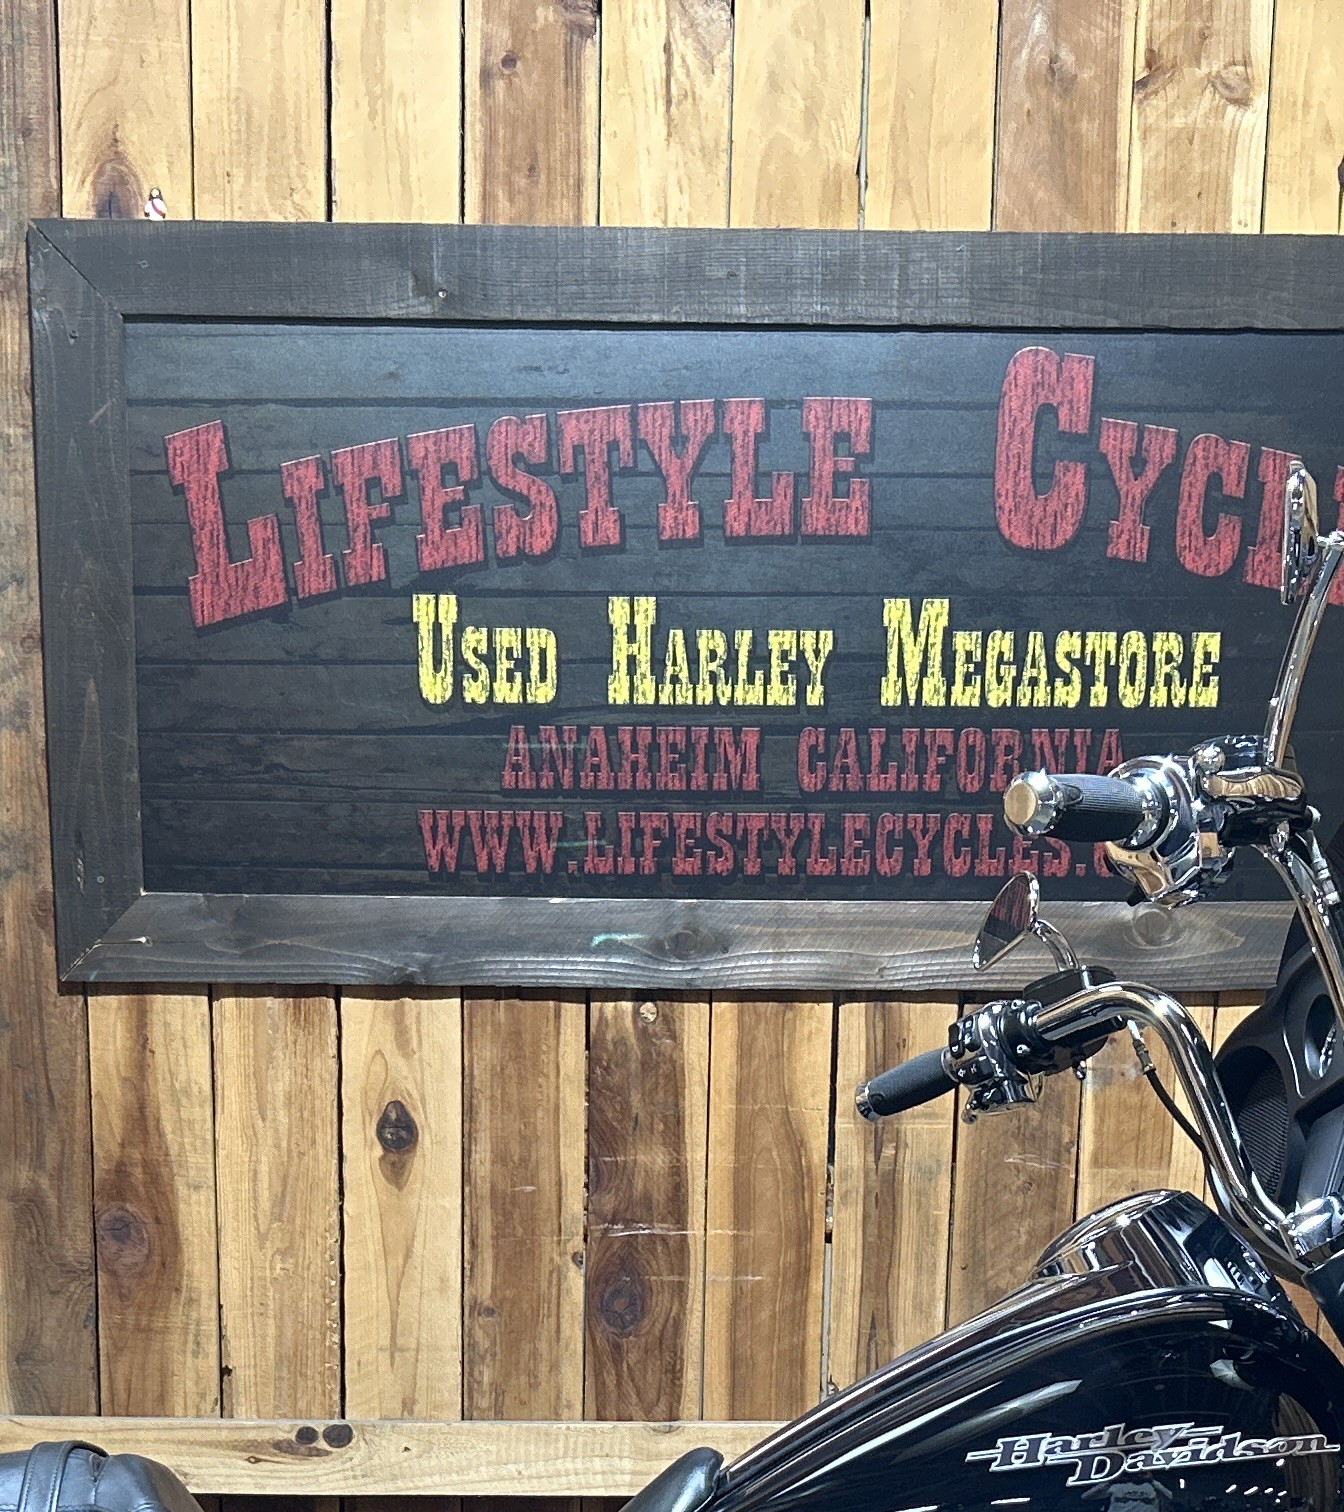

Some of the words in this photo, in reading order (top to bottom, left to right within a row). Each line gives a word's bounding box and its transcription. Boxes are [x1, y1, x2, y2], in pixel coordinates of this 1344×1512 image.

[163, 396, 873, 629] LIFESTYLE
[413, 593, 558, 705] USED
[607, 595, 834, 706] HARLEY
[880, 597, 1222, 708] MEGASTORE
[501, 724, 761, 792] ANAHEIM
[797, 726, 1125, 793] CALIFORNIA
